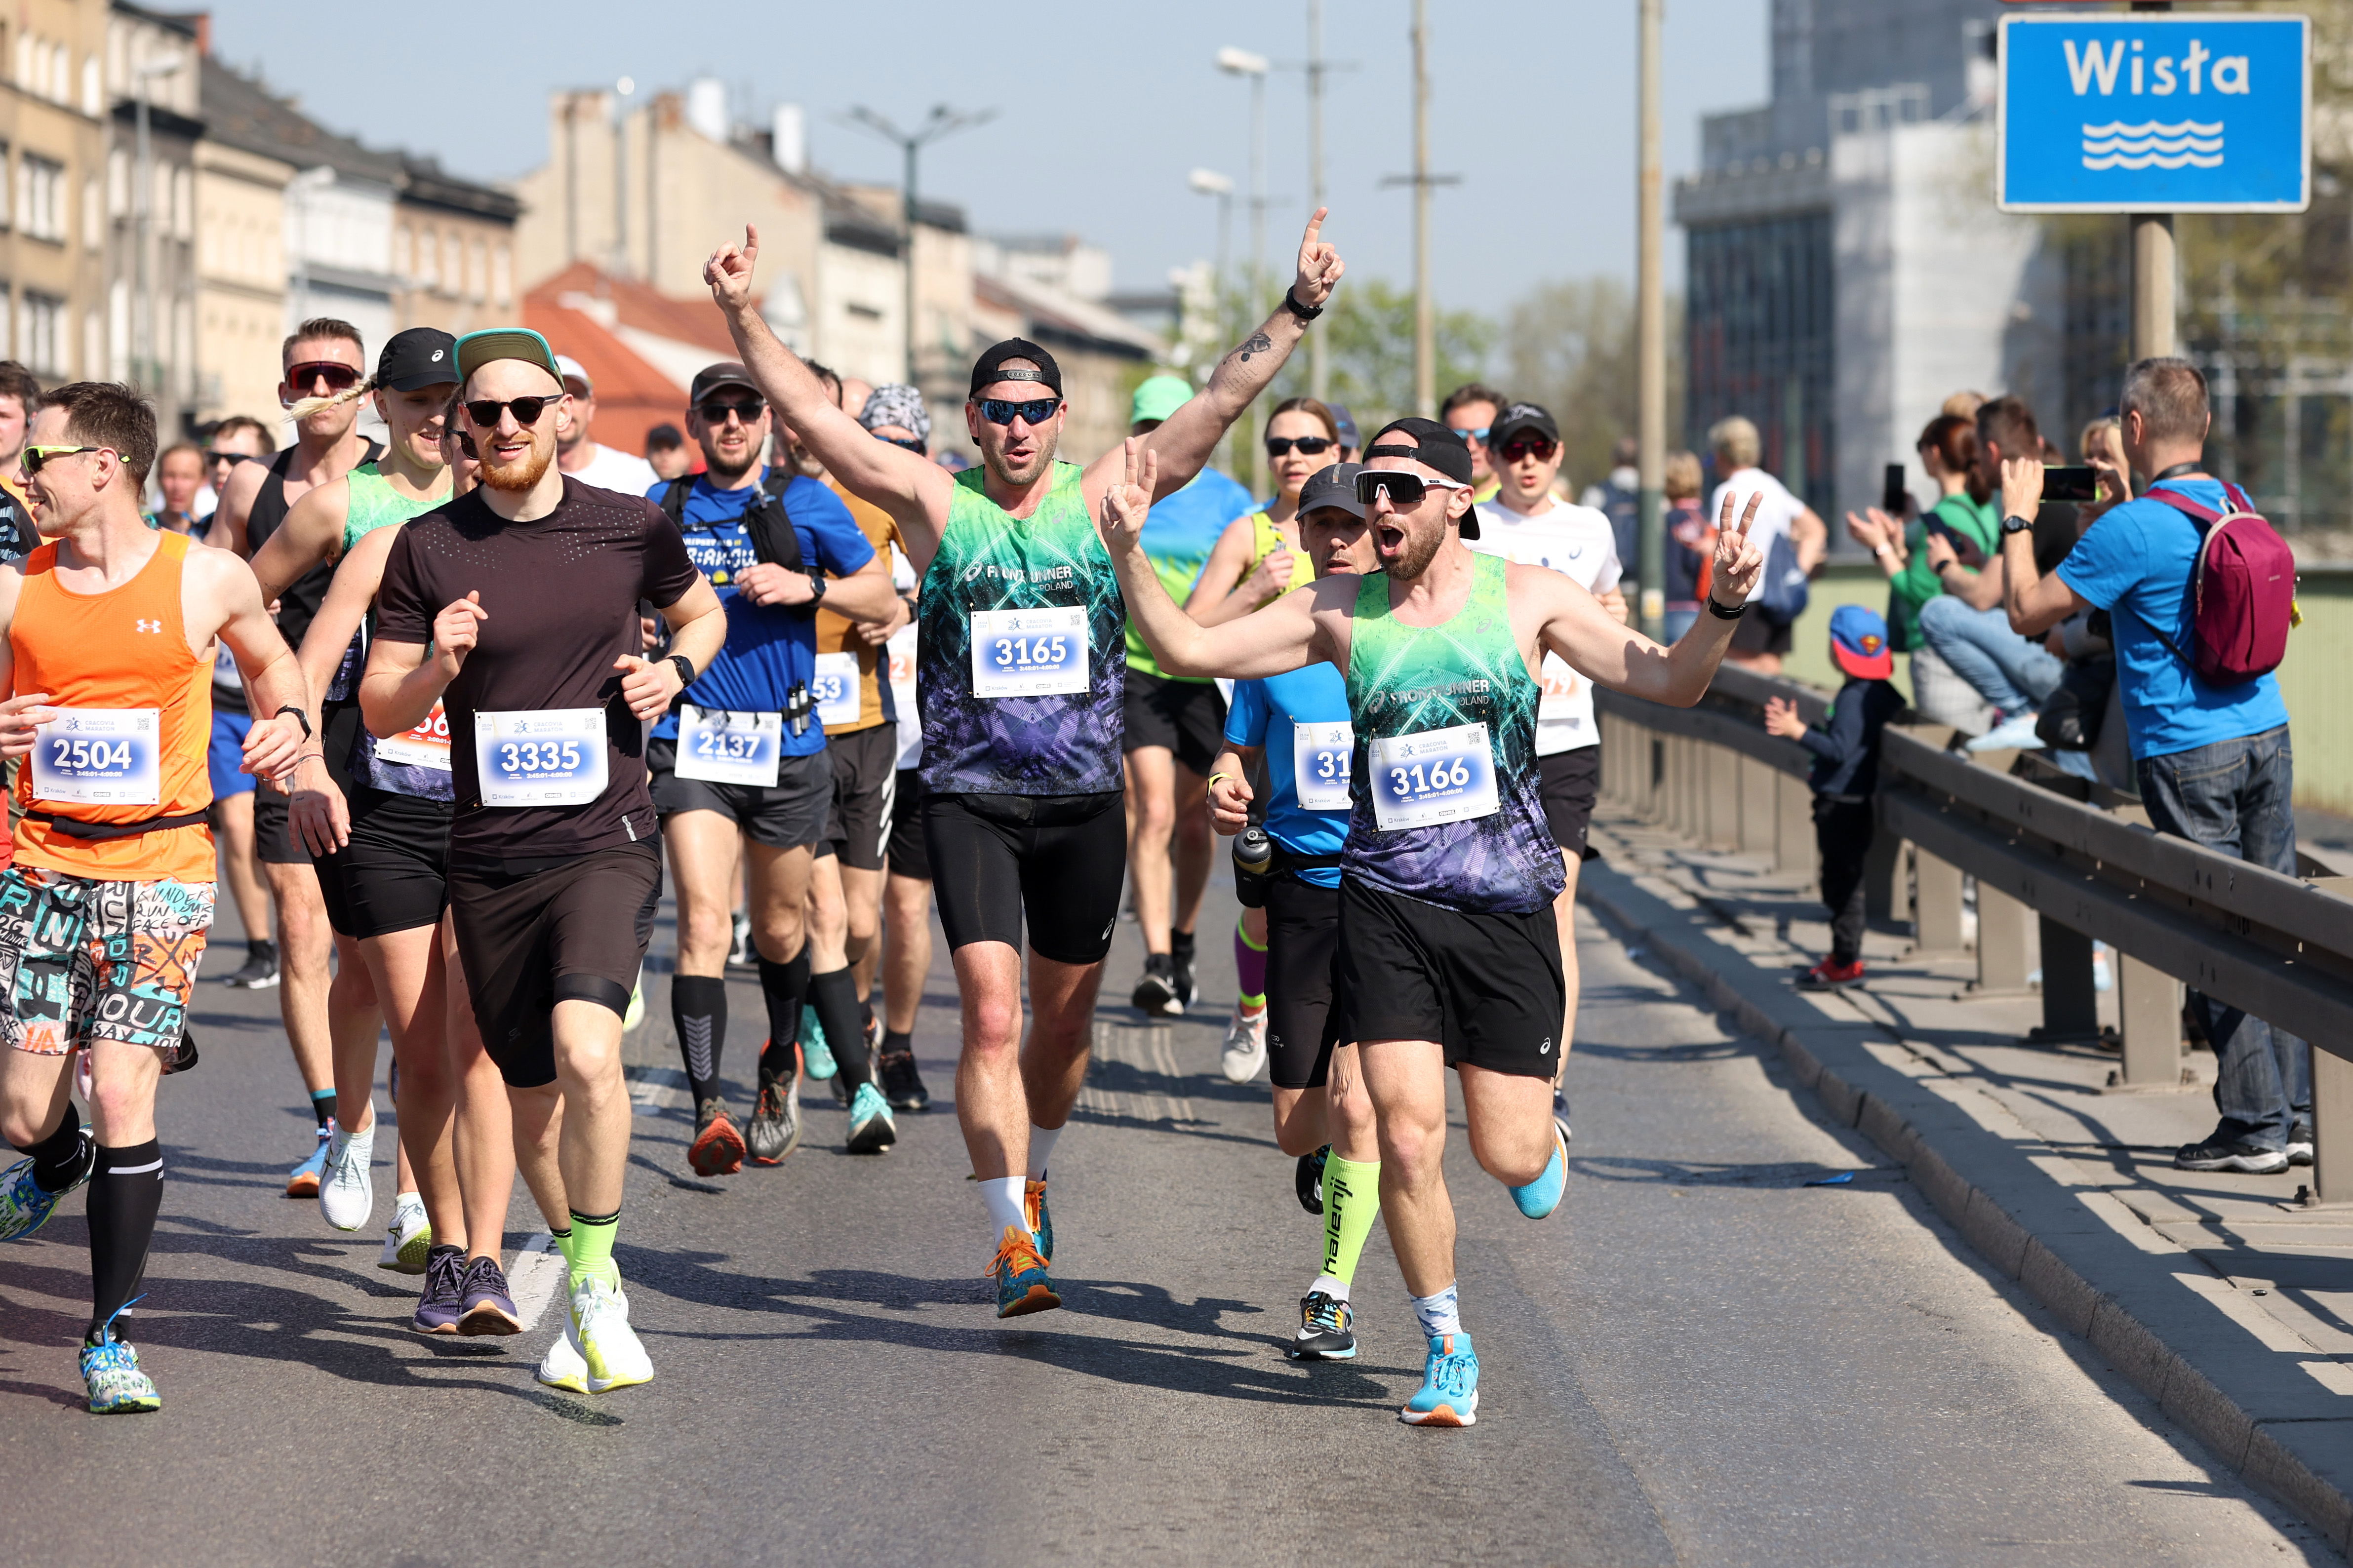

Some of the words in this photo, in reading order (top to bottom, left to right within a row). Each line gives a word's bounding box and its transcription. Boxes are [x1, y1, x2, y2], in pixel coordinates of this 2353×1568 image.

[2063, 39, 2250, 96] Wisła
[1039, 581, 1073, 591] POLAND
[996, 636, 1066, 665] 3165
[812, 676, 841, 700] 53
[1543, 672, 1572, 694] 79
[1454, 695, 1489, 706] POLAND
[53, 739, 132, 769] 2504
[501, 741, 580, 772] 3335
[698, 731, 760, 758] 2137
[1419, 740, 1447, 749] CRACOVIA
[1419, 745, 1448, 754] MARATON
[1317, 751, 1351, 778] 31
[1391, 757, 1469, 795] 3166
[1418, 787, 1463, 800] 3:45:01-4:00:00
[132, 918, 170, 931] FACE
[178, 914, 208, 926] OFF
[1323, 1176, 1353, 1275] kalenji
